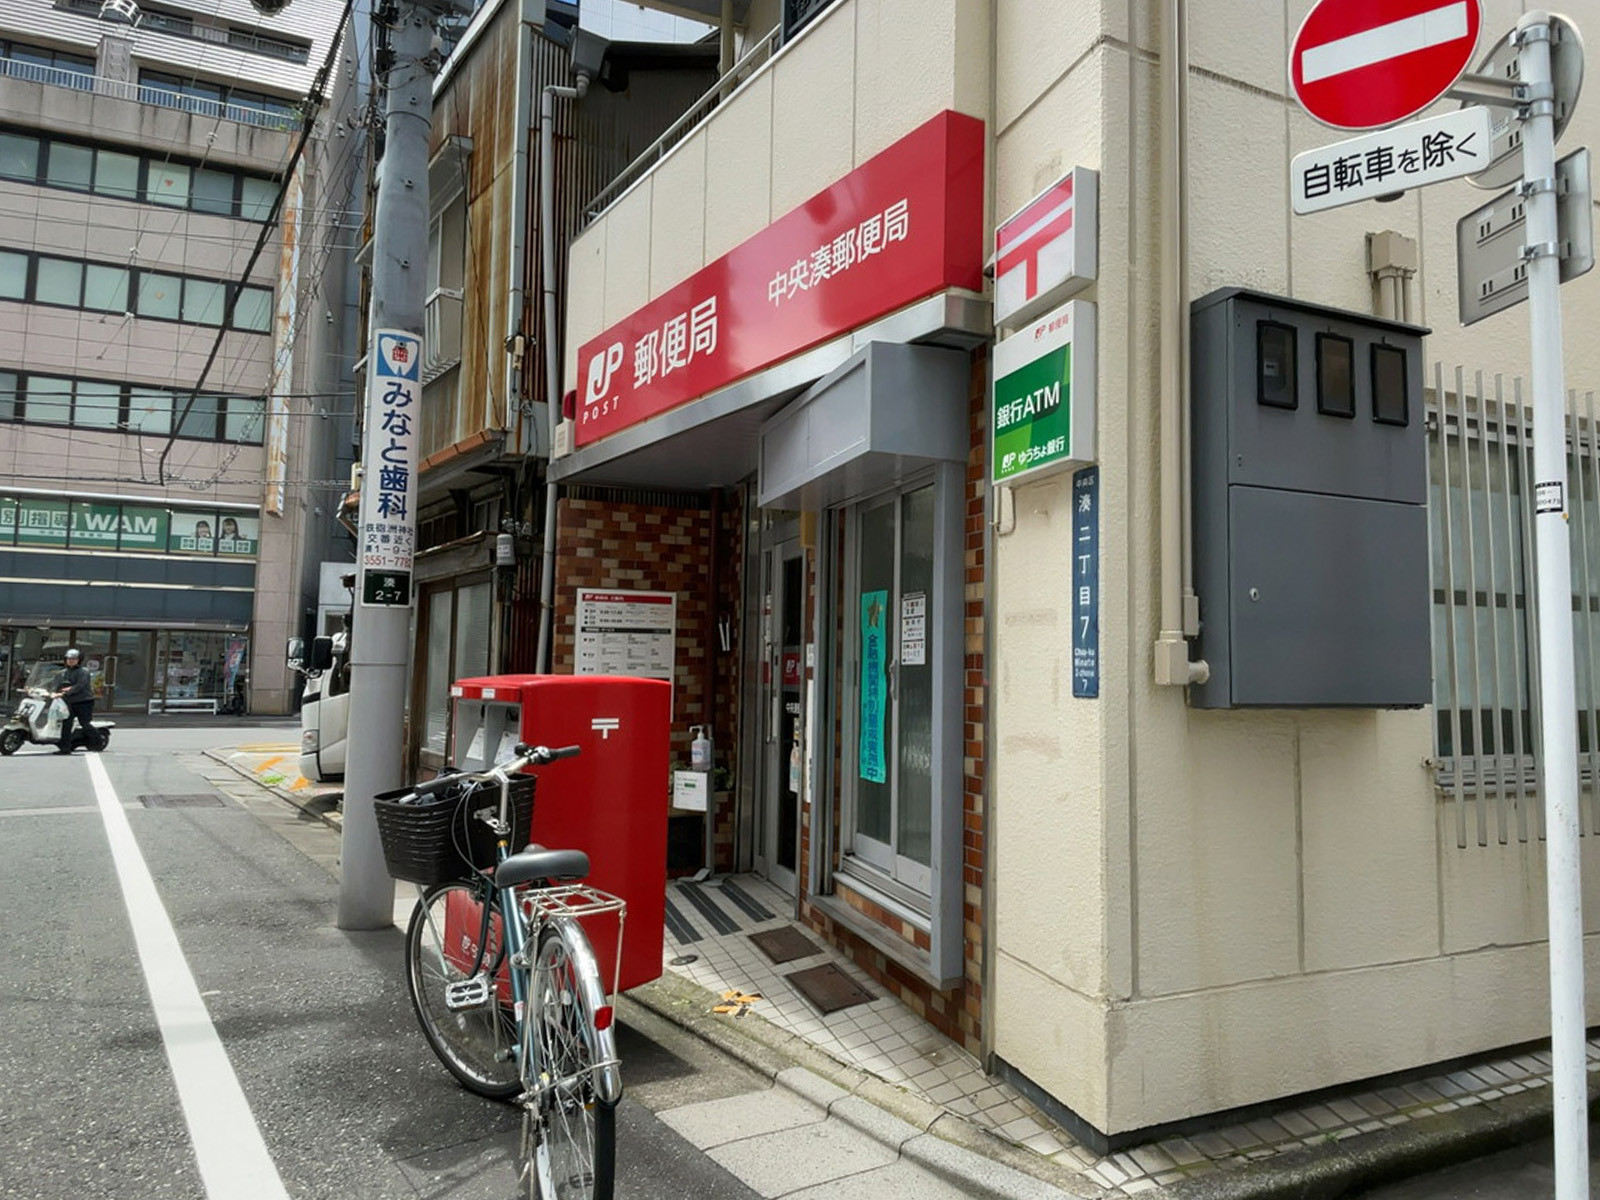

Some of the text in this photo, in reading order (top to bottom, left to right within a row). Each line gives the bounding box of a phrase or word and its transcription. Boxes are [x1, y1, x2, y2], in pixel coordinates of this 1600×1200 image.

[1303, 131, 1477, 199] 自転車を除く
[768, 198, 908, 307] 中央湊郵便局
[633, 295, 718, 390] 郵便局
[582, 396, 619, 424] POST
[996, 381, 1060, 429] 銀行ATM
[377, 381, 413, 521] みなと歯科
[1018, 436, 1065, 466] ゆうちょ銀行
[85, 513, 157, 534] WAM
[375, 590, 402, 601] 2-7
[1081, 678, 1089, 692] 7
